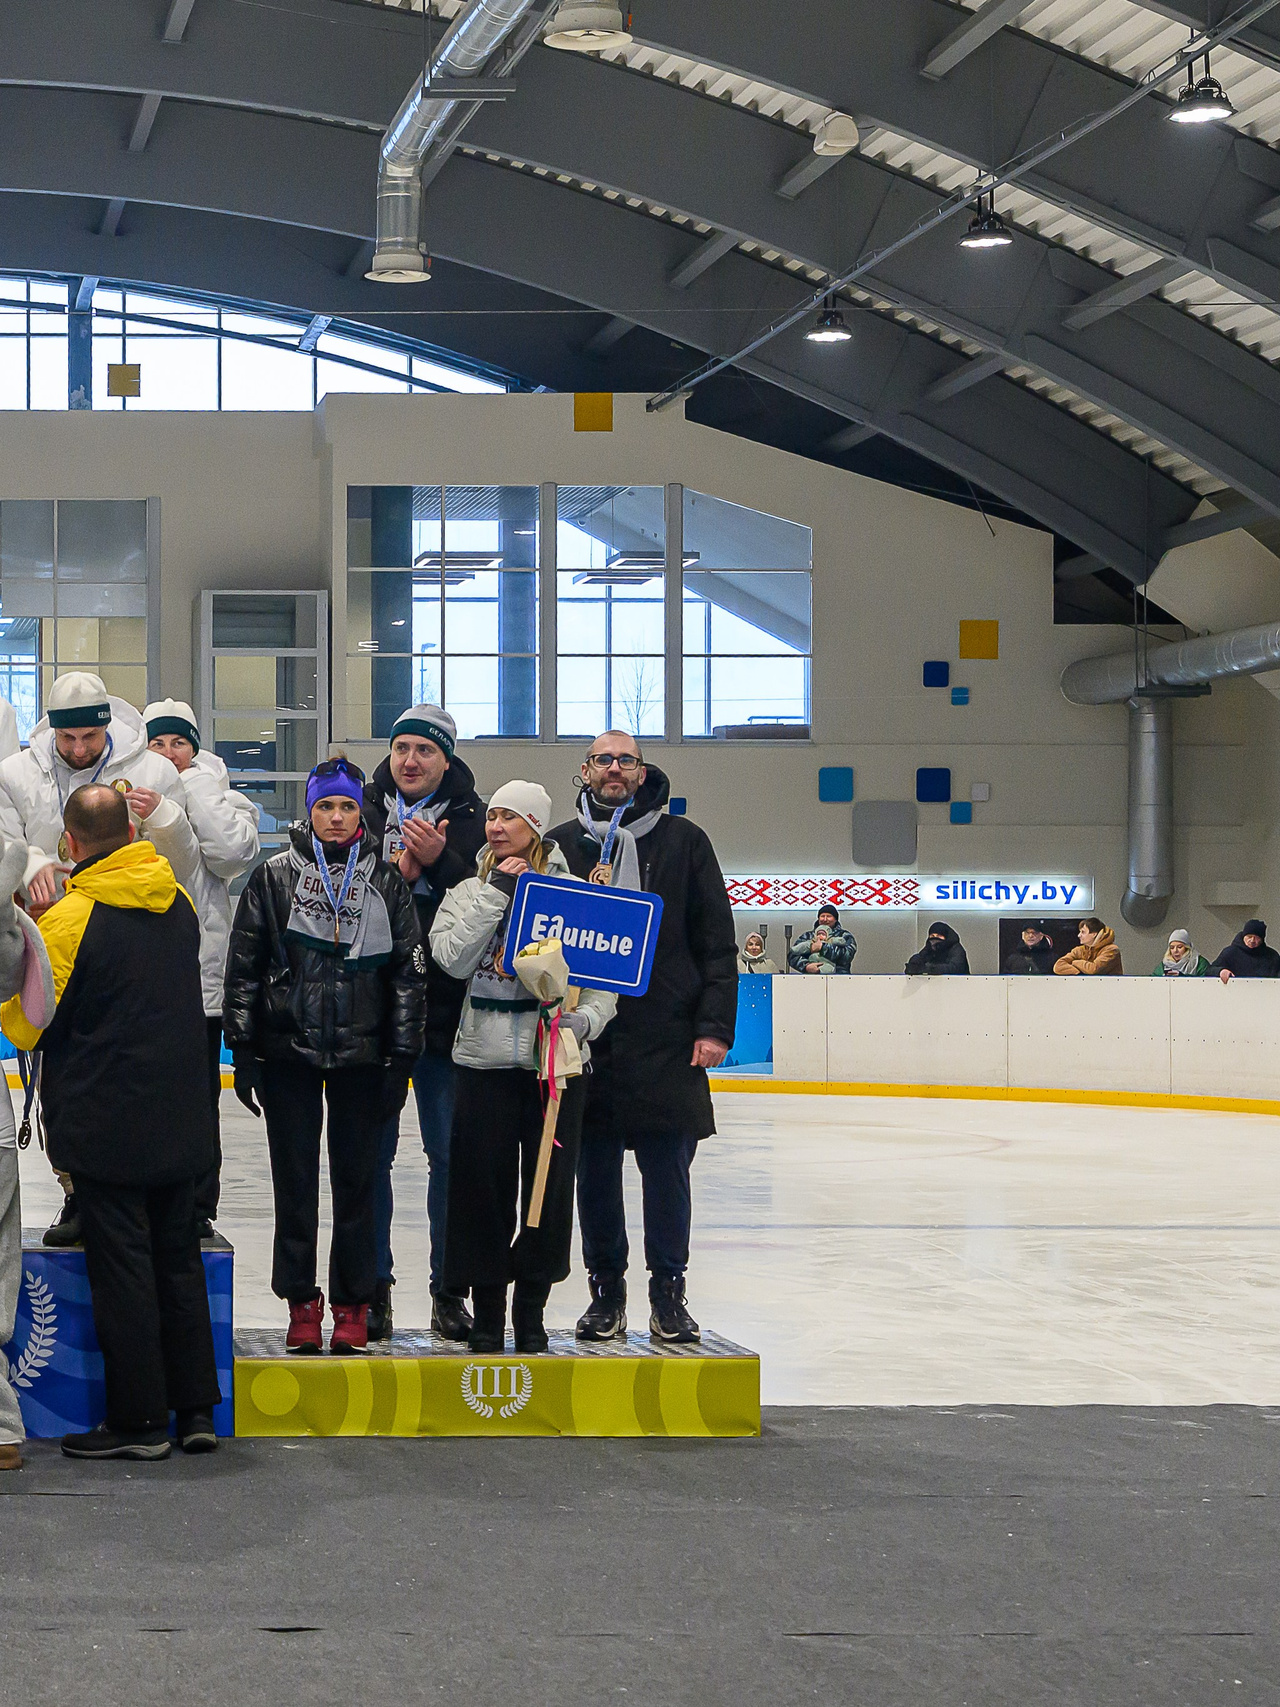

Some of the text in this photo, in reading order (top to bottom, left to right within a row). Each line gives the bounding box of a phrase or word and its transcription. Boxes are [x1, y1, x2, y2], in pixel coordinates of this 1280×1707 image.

[936, 880, 1078, 905] silichy.by
[531, 913, 633, 957] Единые
[473, 1366, 522, 1398] III
